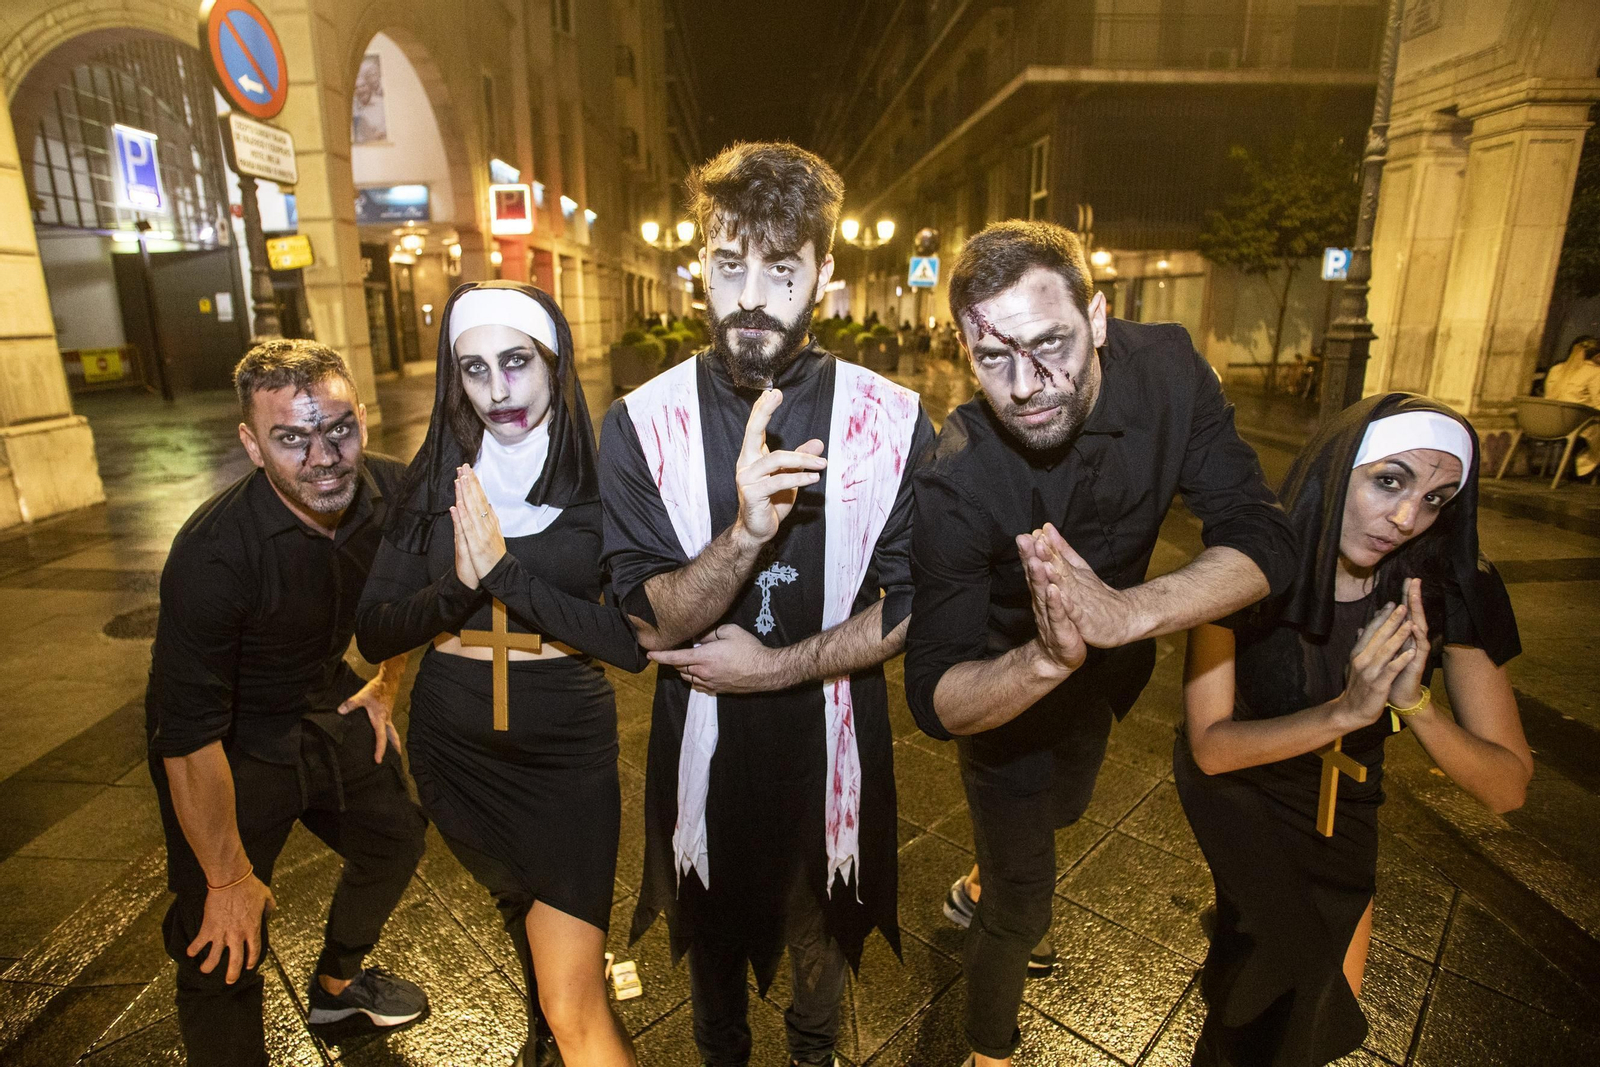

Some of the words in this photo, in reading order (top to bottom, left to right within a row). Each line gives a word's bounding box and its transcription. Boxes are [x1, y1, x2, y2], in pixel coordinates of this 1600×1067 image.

[123, 137, 148, 184] P
[500, 191, 520, 218] P
[1326, 250, 1346, 279] P
